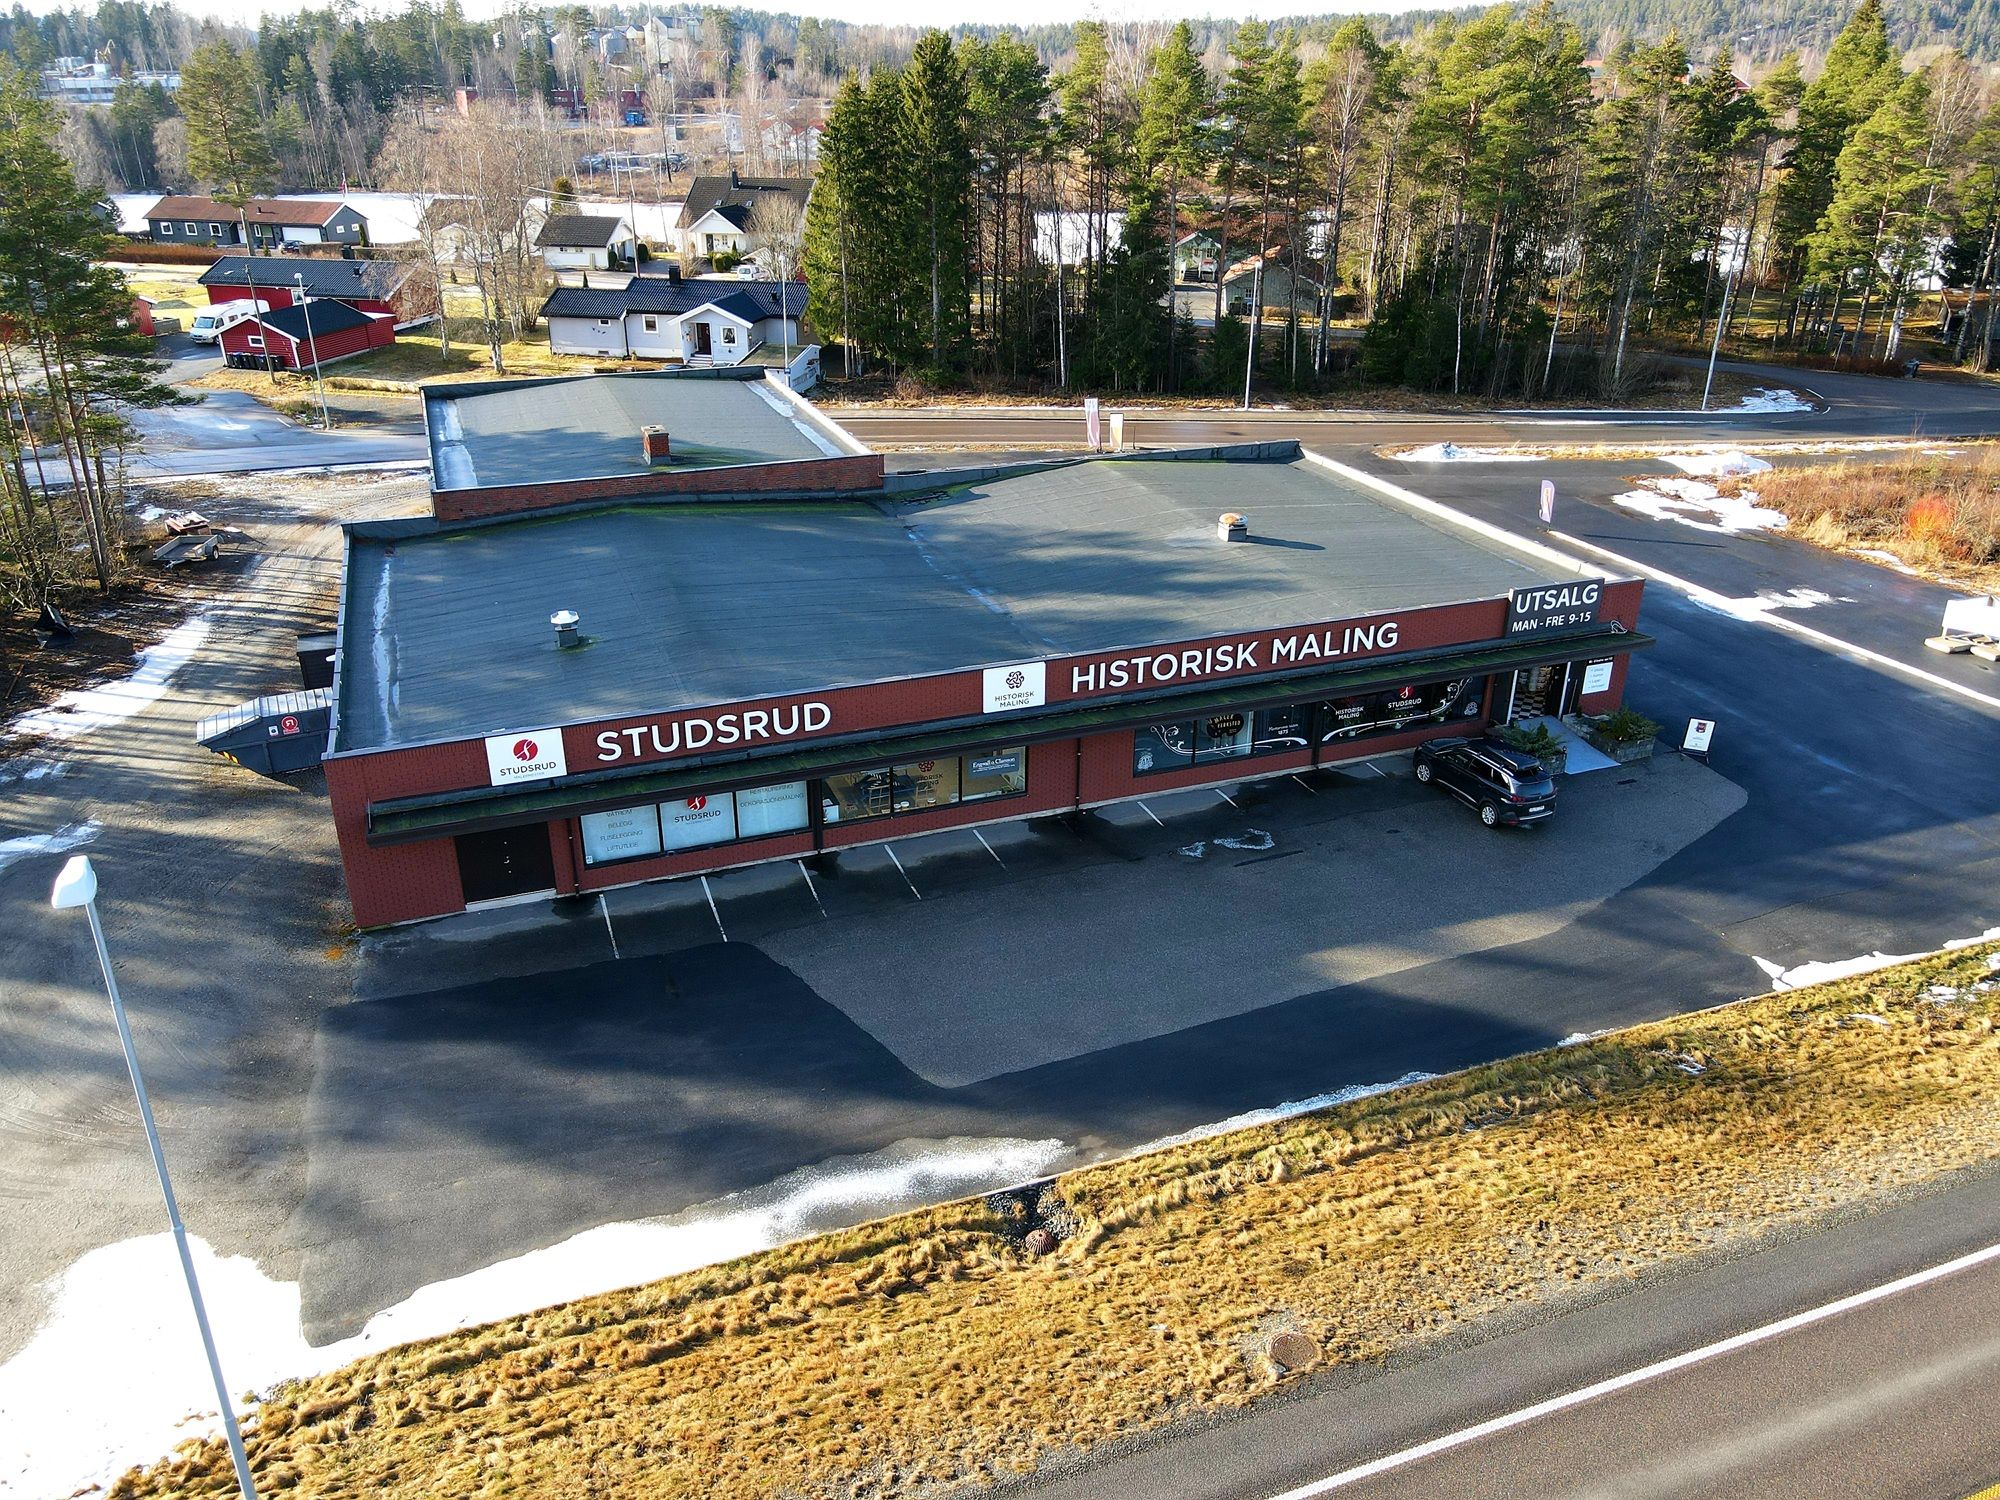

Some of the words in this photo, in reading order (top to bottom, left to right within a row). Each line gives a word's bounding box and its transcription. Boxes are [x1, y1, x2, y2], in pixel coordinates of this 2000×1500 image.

[1516, 583, 1599, 614] UTSALG
[1511, 618, 1538, 633] MAN
[1545, 614, 1566, 628] FRE
[1568, 611, 1592, 625] 9-15
[1072, 640, 1259, 693] HISTORISK
[1271, 622, 1399, 664] MALING
[994, 690, 1035, 702] HISTORISK
[999, 698, 1030, 708] MALING
[1387, 698, 1422, 709] STUDSRUD
[1335, 706, 1365, 716] HISTORISK
[1338, 711, 1360, 720] MALING
[596, 702, 832, 761] STUDSRUD
[499, 761, 557, 777] STUDSRUD
[674, 810, 721, 823] STUDSRUD
